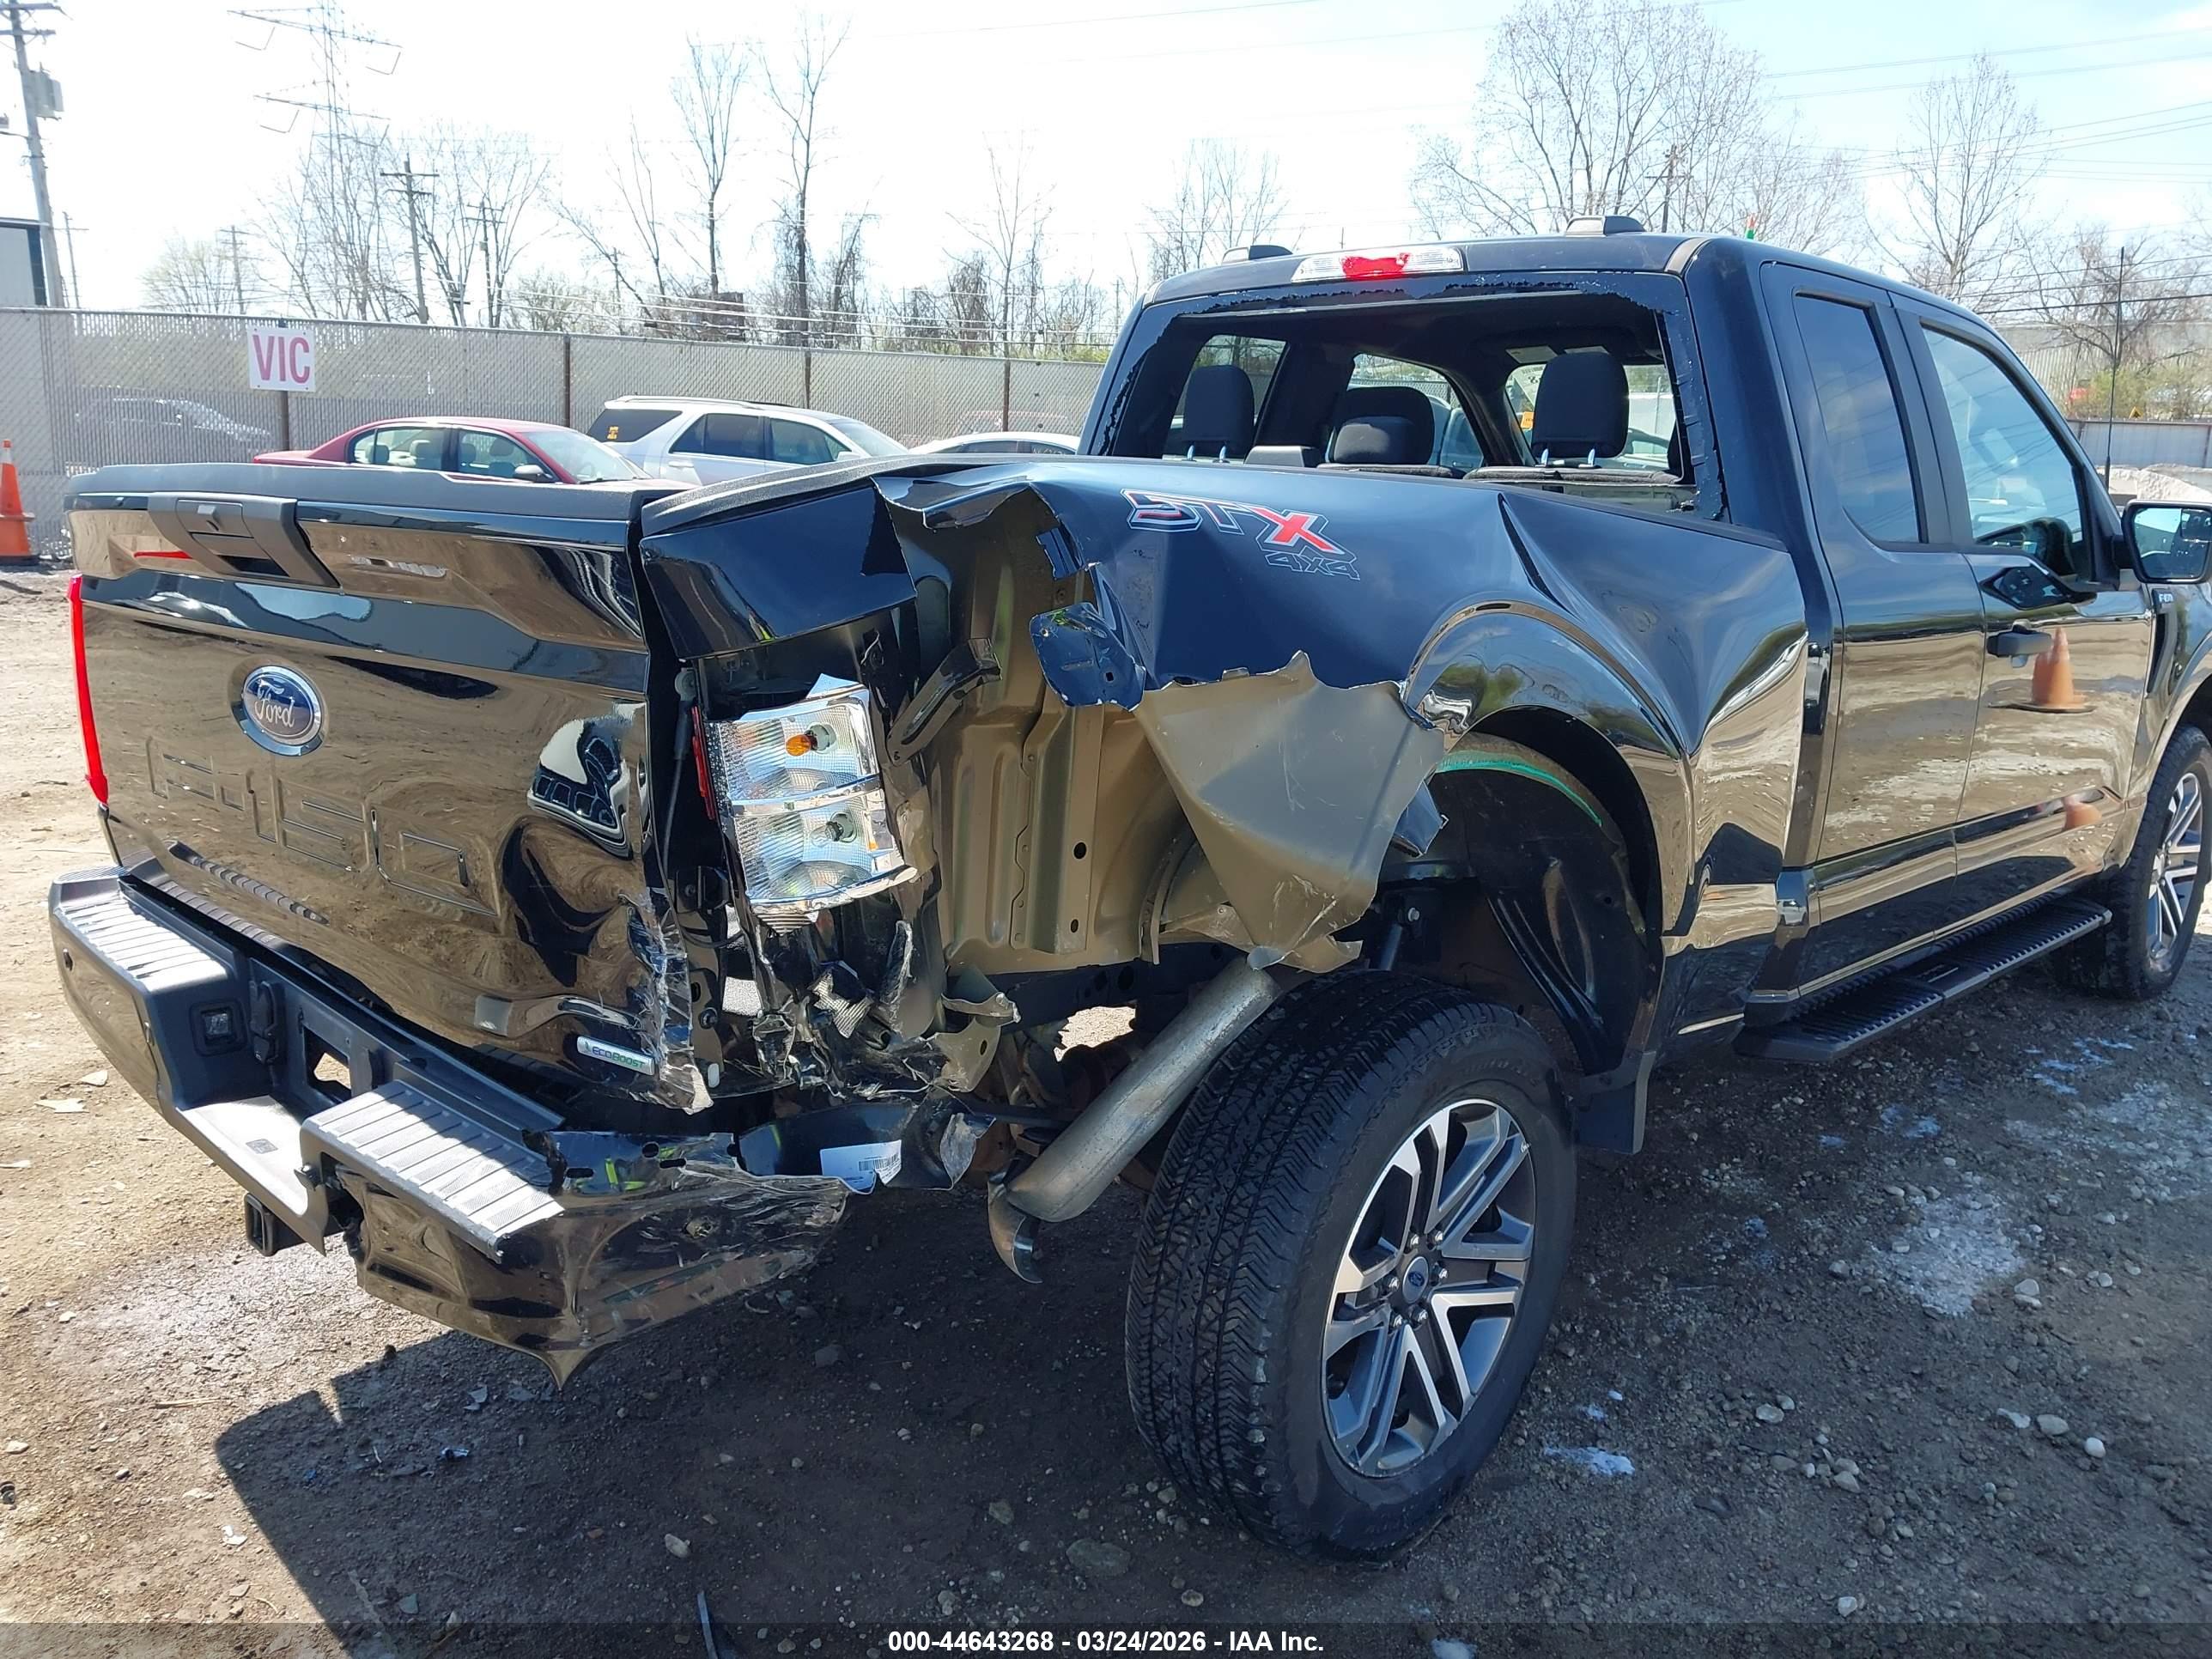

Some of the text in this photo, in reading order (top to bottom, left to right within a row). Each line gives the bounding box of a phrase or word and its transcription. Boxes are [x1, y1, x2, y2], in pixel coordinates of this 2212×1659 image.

[252, 334, 311, 384] VIC
[1120, 488, 1358, 563] STX
[254, 678, 296, 728] Ford
